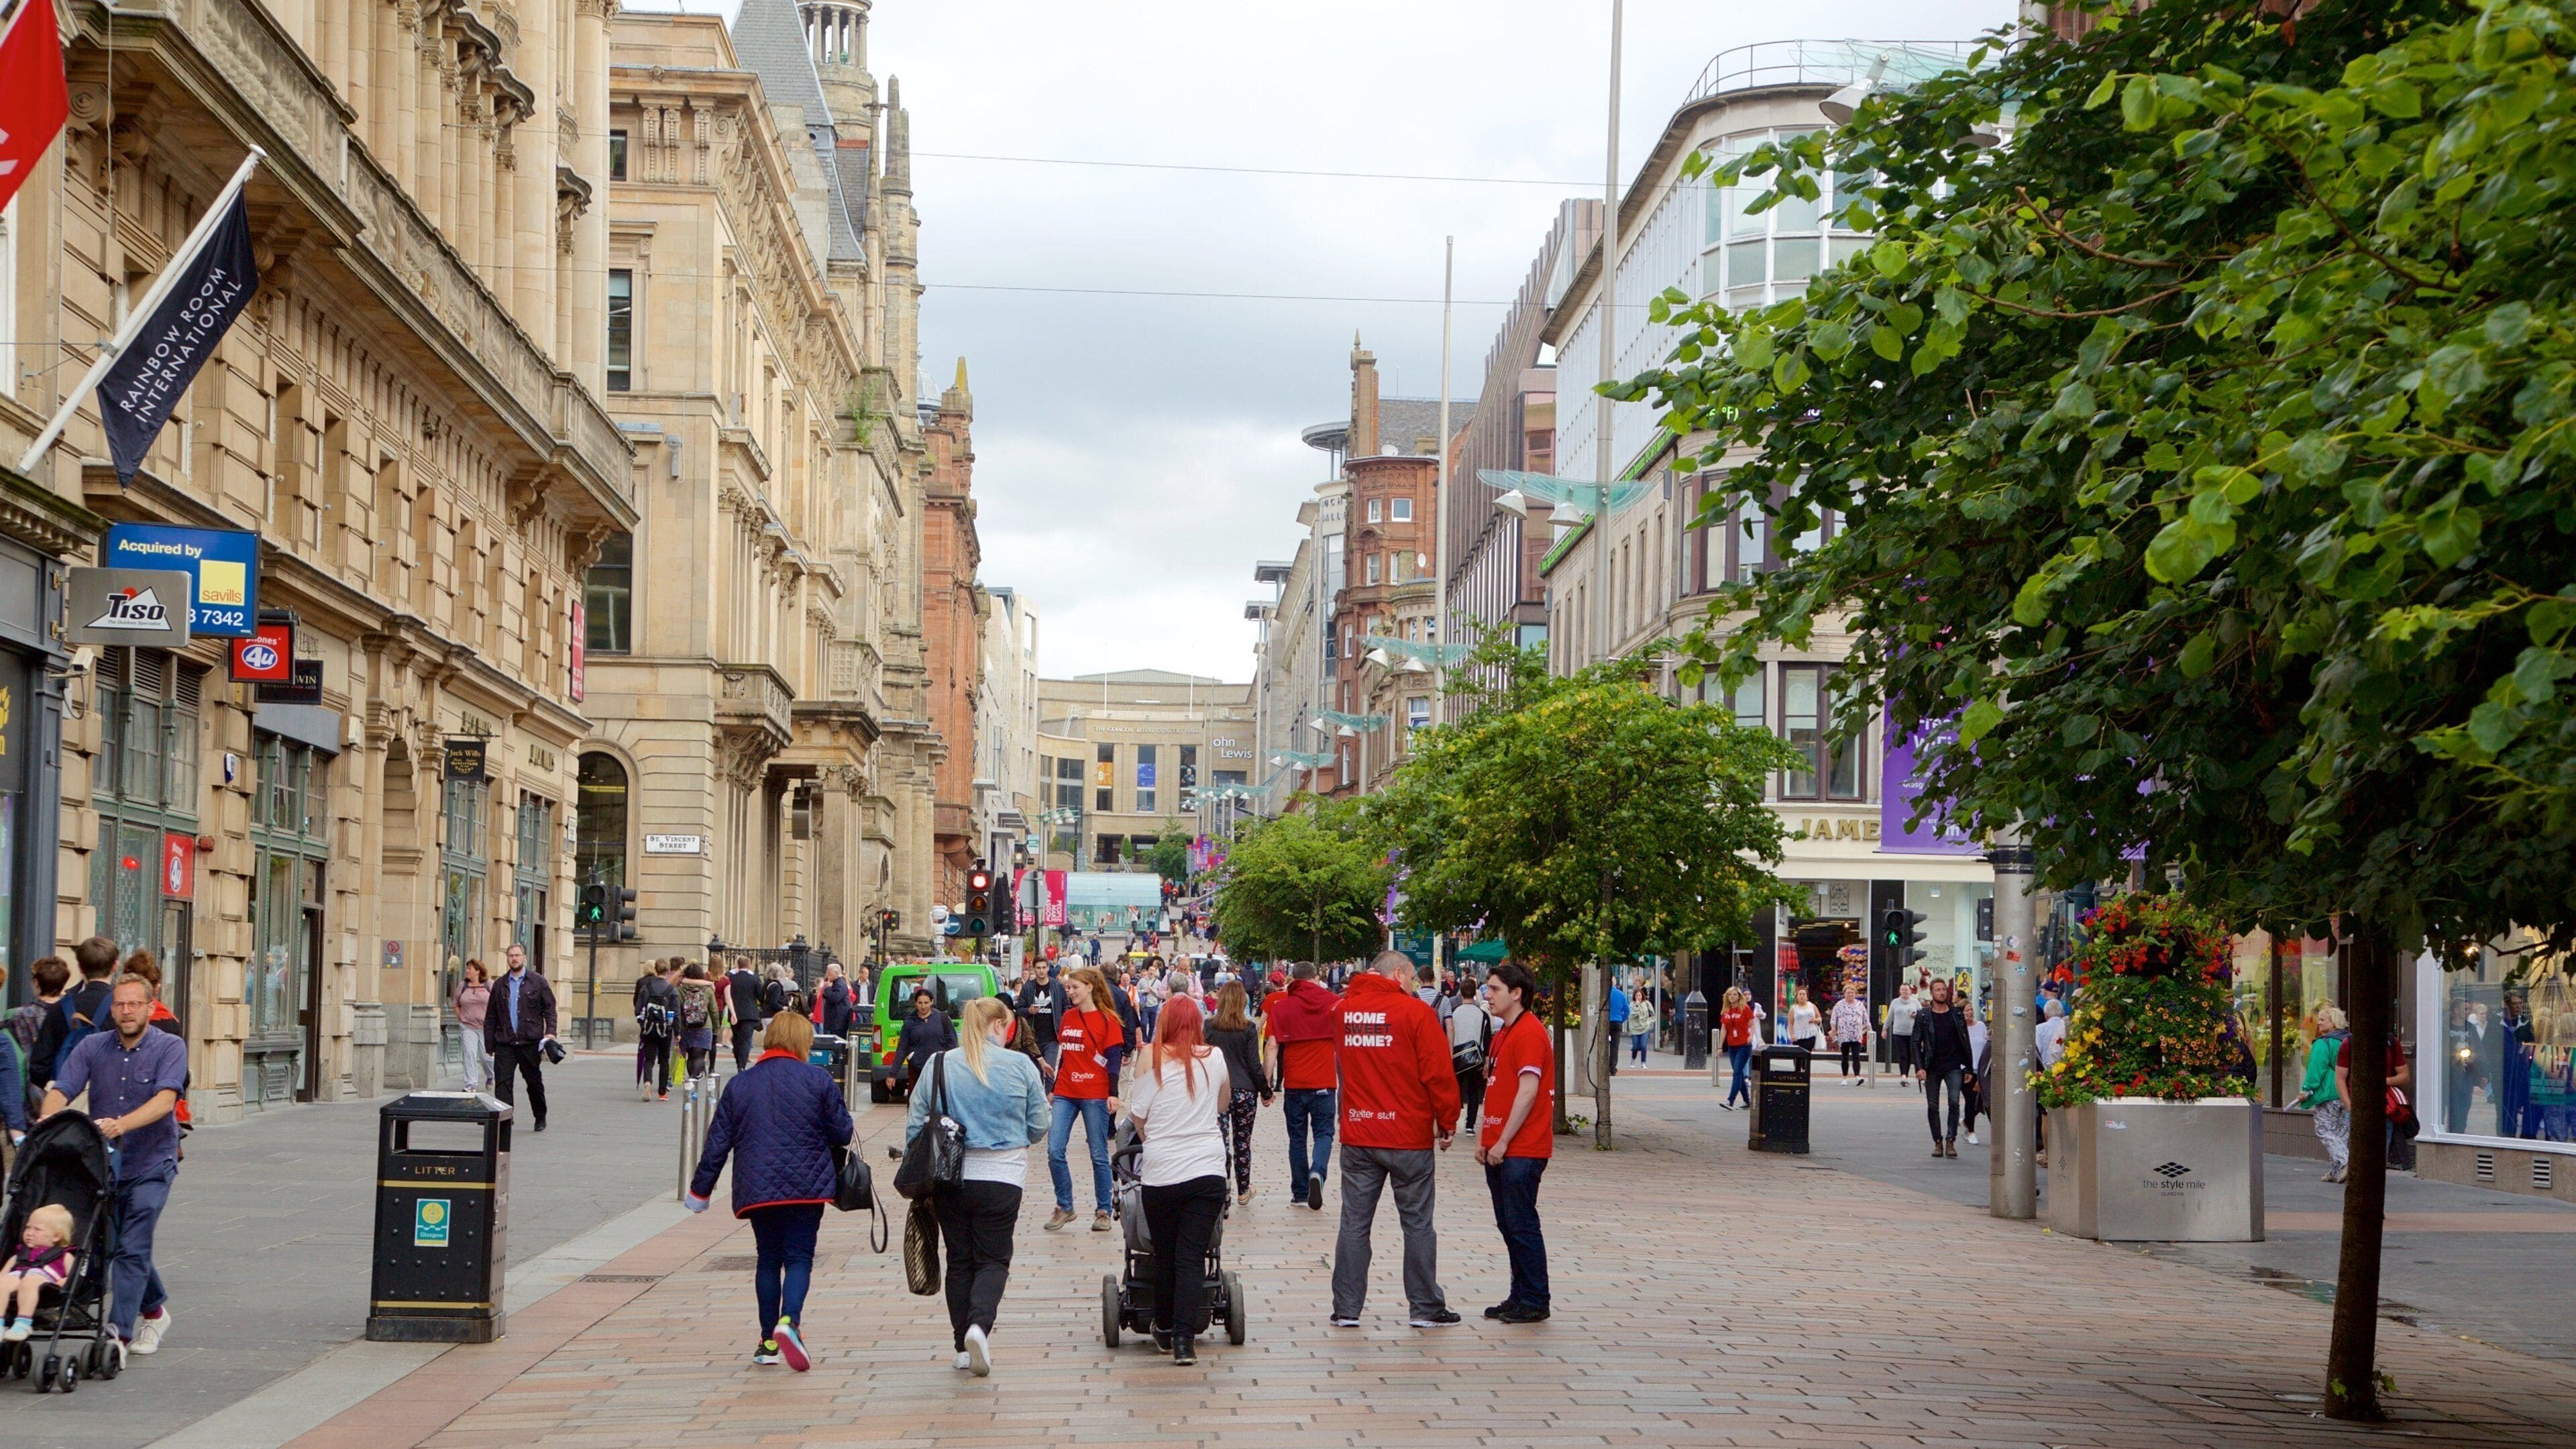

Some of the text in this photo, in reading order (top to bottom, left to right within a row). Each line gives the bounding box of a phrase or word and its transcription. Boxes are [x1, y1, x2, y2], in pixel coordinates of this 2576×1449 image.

[119, 268, 227, 413] RAINBOW ROOM
[135, 281, 242, 423] INTERNATIONAL
[119, 539, 202, 558] Acquired by
[202, 589, 242, 603] savills
[202, 610, 244, 627] 7342
[295, 675, 317, 684] WIN
[1213, 735, 1235, 747] ohn
[1222, 747, 1252, 759] Lewis
[1802, 818, 1880, 840] JAME
[1344, 1012, 1386, 1024] HOME
[1344, 1024, 1391, 1034] SWEET
[1344, 1034, 1393, 1047] HOME?
[1062, 1042, 1085, 1052] OME?
[1071, 1071, 1095, 1079] Shelter
[1349, 1108, 1374, 1118] Shelter
[415, 1166, 455, 1175] LITTER
[2143, 1179, 2206, 1190] the style mile
